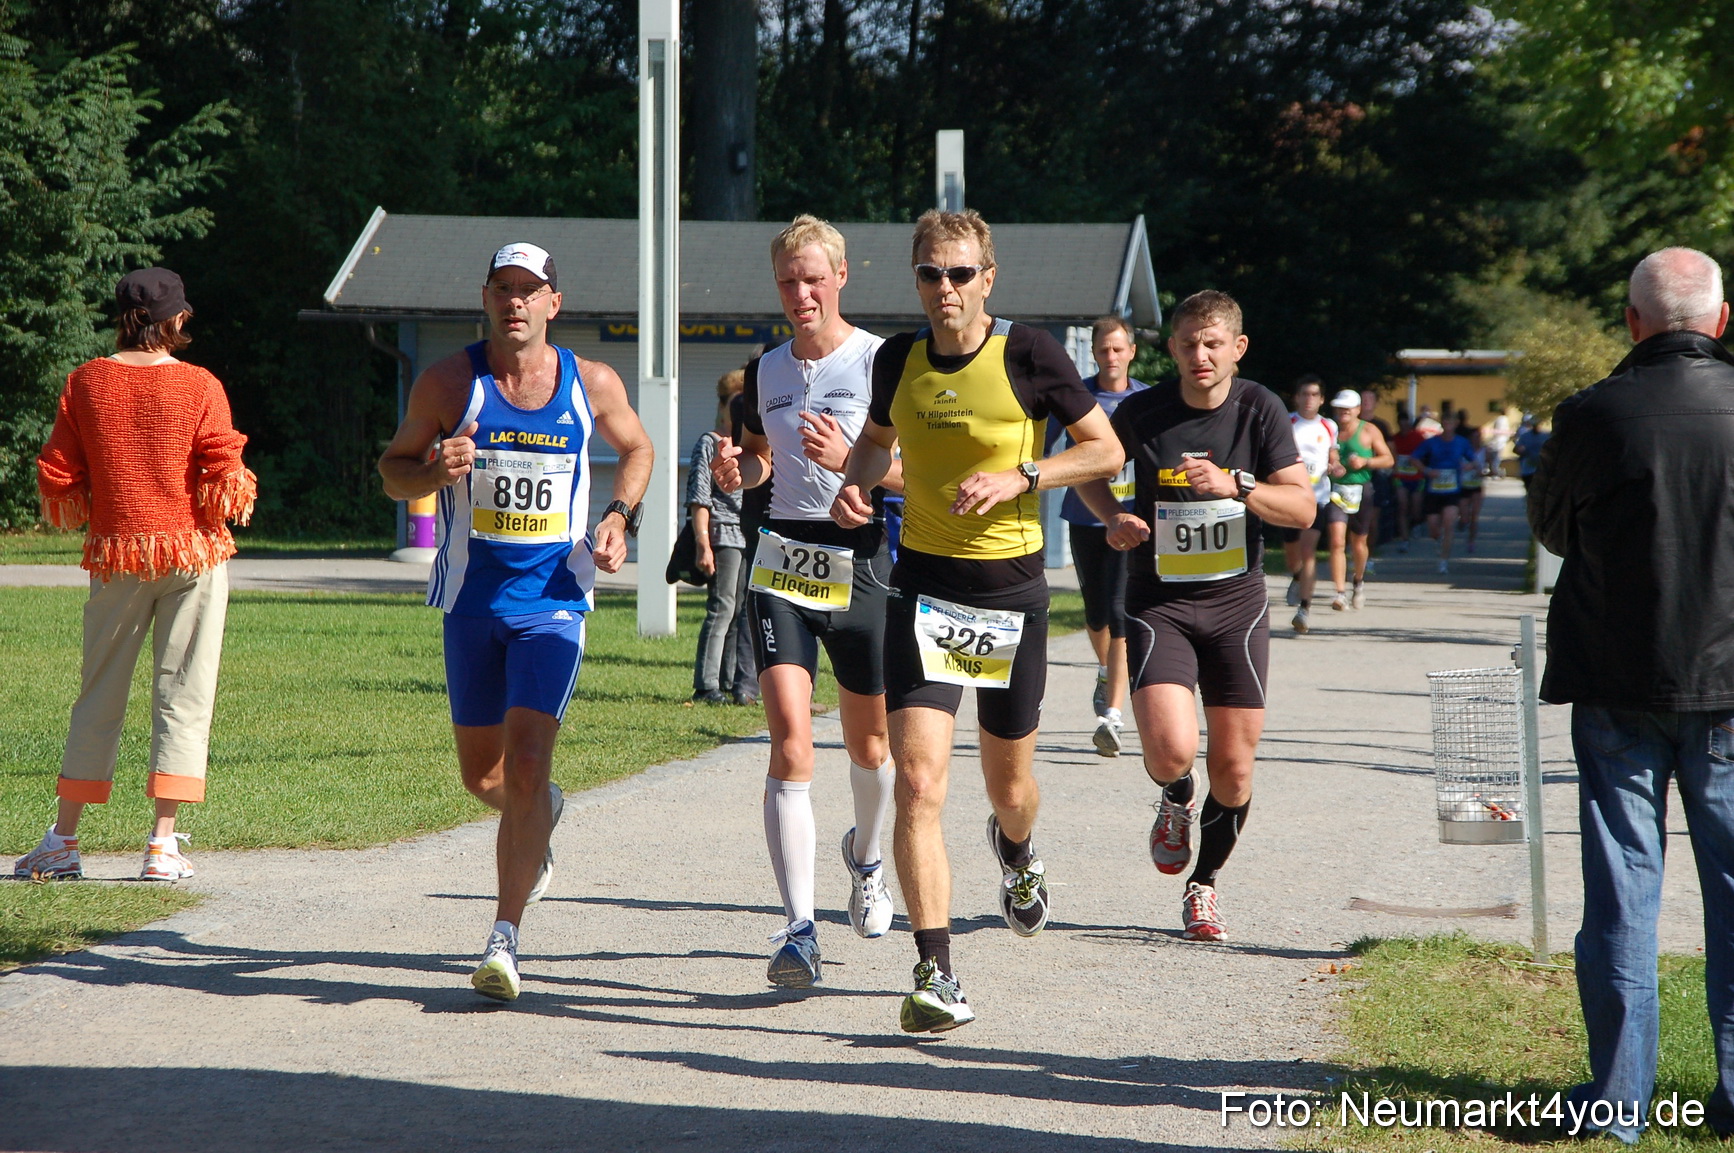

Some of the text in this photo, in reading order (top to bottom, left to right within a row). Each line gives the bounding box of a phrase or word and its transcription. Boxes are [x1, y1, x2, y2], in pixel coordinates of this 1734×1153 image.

[917, 408, 973, 419] TV Hilpoltstein
[927, 421, 962, 430] Triathlon
[490, 431, 569, 448] LAC QUELLE
[487, 458, 533, 470] PFLEIDERER
[494, 475, 553, 511] 896
[494, 511, 548, 532] Stefan
[1168, 508, 1208, 516] PFLEIDERER
[1175, 521, 1229, 553] 910
[779, 544, 831, 580] 128
[770, 571, 830, 599] Florian
[762, 618, 777, 652] 2XU
[935, 625, 997, 657] 226
[943, 653, 983, 674] Klaus
